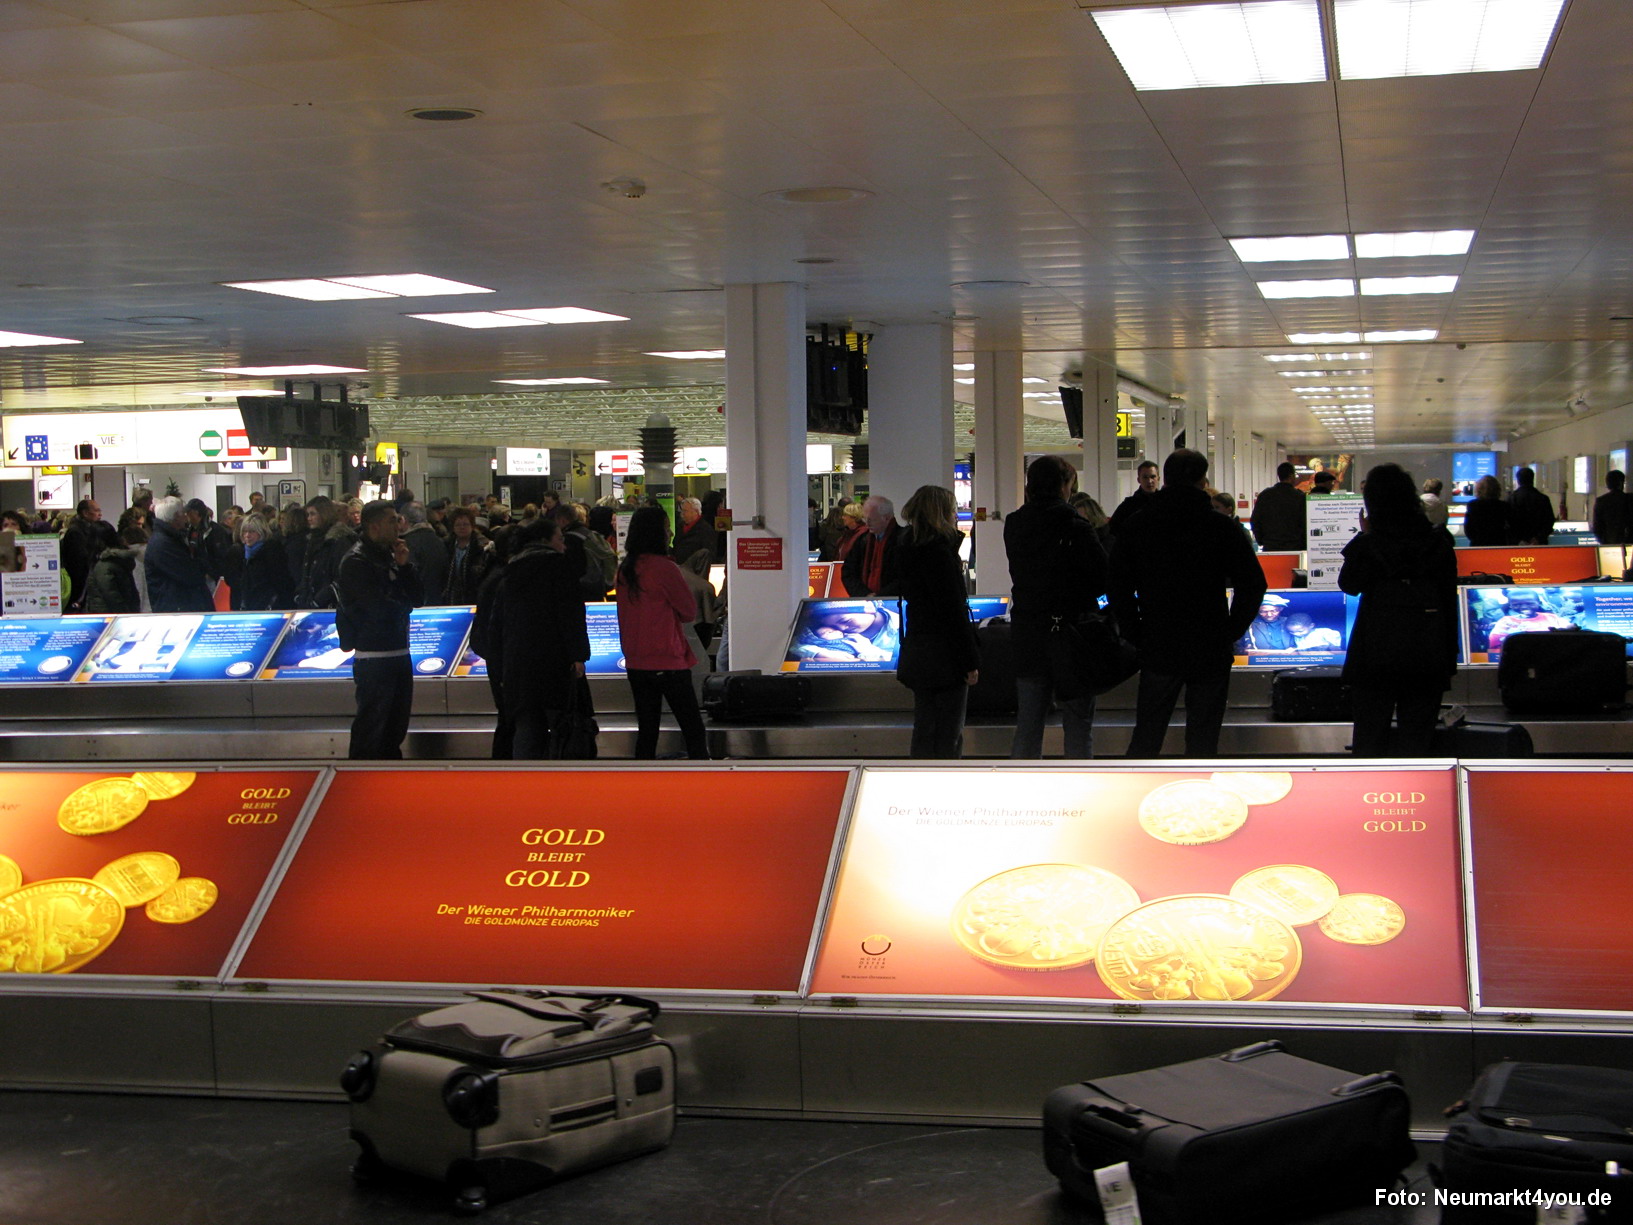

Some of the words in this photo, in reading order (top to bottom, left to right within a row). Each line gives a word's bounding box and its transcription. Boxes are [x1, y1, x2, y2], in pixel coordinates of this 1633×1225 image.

[100, 436, 115, 445] VIE
[387, 454, 396, 464] WC
[283, 484, 290, 493] P
[241, 788, 291, 800] GOLD
[1363, 792, 1426, 804] GOLD
[888, 806, 912, 816] Der
[918, 807, 966, 816] Wiener
[973, 807, 1086, 818] Philharmoniker
[227, 813, 278, 825] GOLD
[1363, 821, 1427, 832] GOLD
[521, 828, 605, 846] GOLD
[527, 852, 585, 862] BLEIBT
[505, 870, 590, 887] GOLD
[437, 904, 464, 915] Der
[468, 904, 518, 916] Wiener
[521, 905, 635, 918] Philharmoniker
[484, 917, 549, 926] GOLDMÜNZE
[550, 918, 600, 926] EUROPAS
